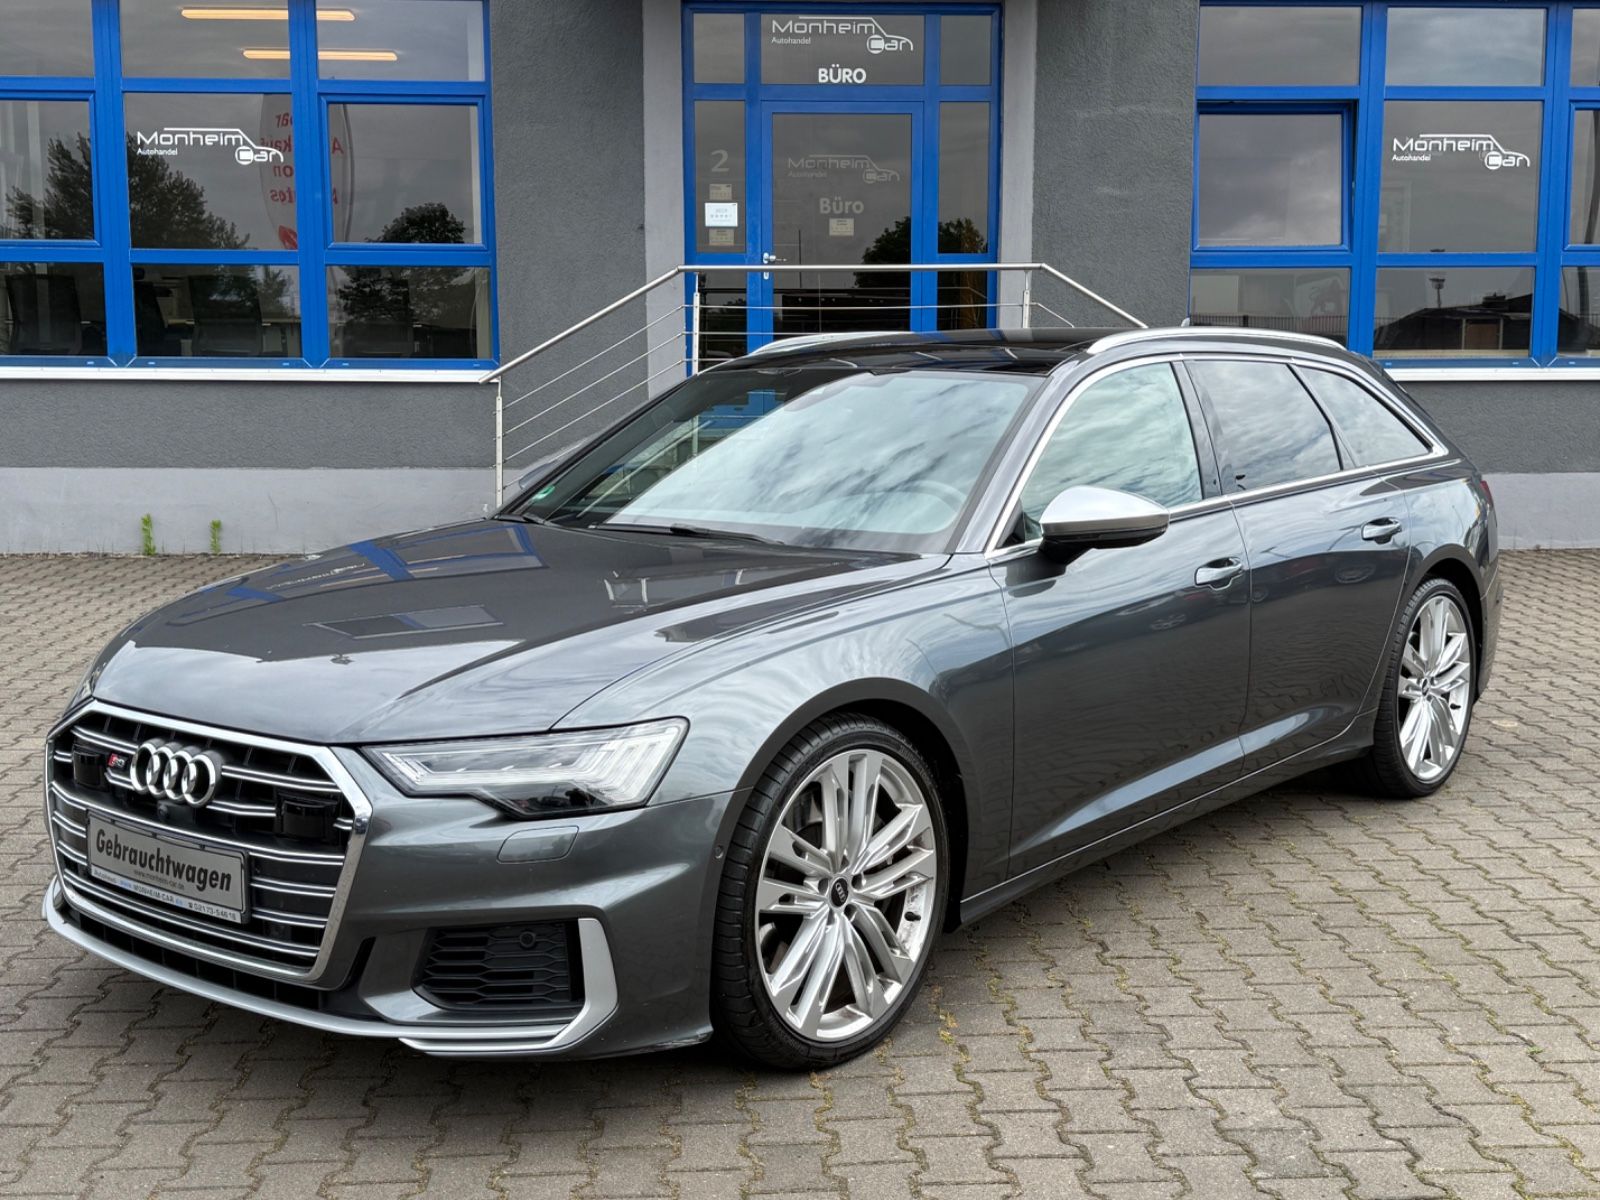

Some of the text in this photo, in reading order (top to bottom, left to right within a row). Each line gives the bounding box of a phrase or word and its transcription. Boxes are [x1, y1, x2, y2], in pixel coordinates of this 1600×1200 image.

[771, 19, 875, 35] Monheim
[771, 36, 812, 45] Autohandel
[818, 63, 867, 84] BÜRO
[136, 130, 244, 146] Monheim
[1392, 137, 1494, 152] Monheim
[136, 147, 178, 156] Autohandel
[1391, 153, 1432, 162] Autohandel
[711, 149, 730, 173] 2
[788, 157, 871, 169] Monheim
[820, 196, 865, 215] Büro
[96, 828, 232, 893] Gebrauchtwagen
